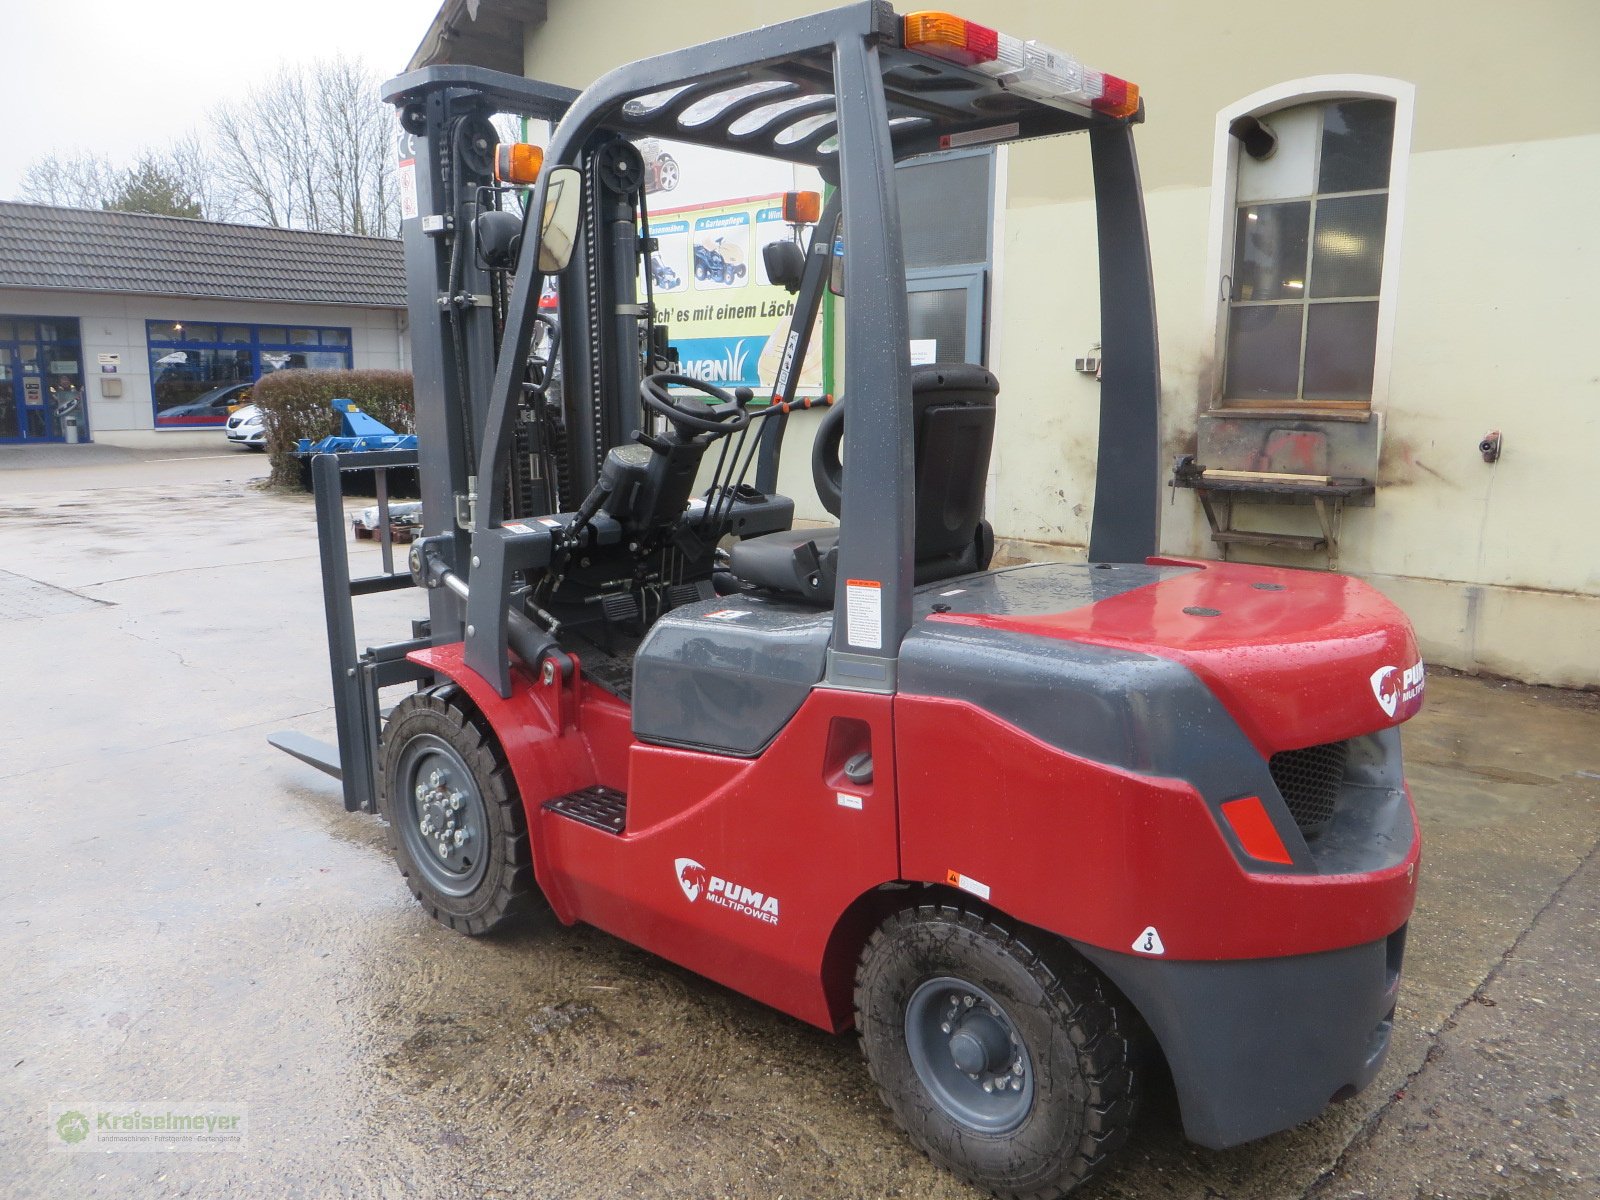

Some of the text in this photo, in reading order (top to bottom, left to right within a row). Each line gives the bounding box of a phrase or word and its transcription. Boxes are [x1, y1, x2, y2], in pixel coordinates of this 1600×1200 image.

[676, 309, 690, 322] es
[693, 305, 713, 321] mit
[716, 304, 757, 320] einem
[760, 299, 795, 318] Läch
[706, 892, 779, 926] MULTIPOWER
[708, 876, 779, 915] PUMA
